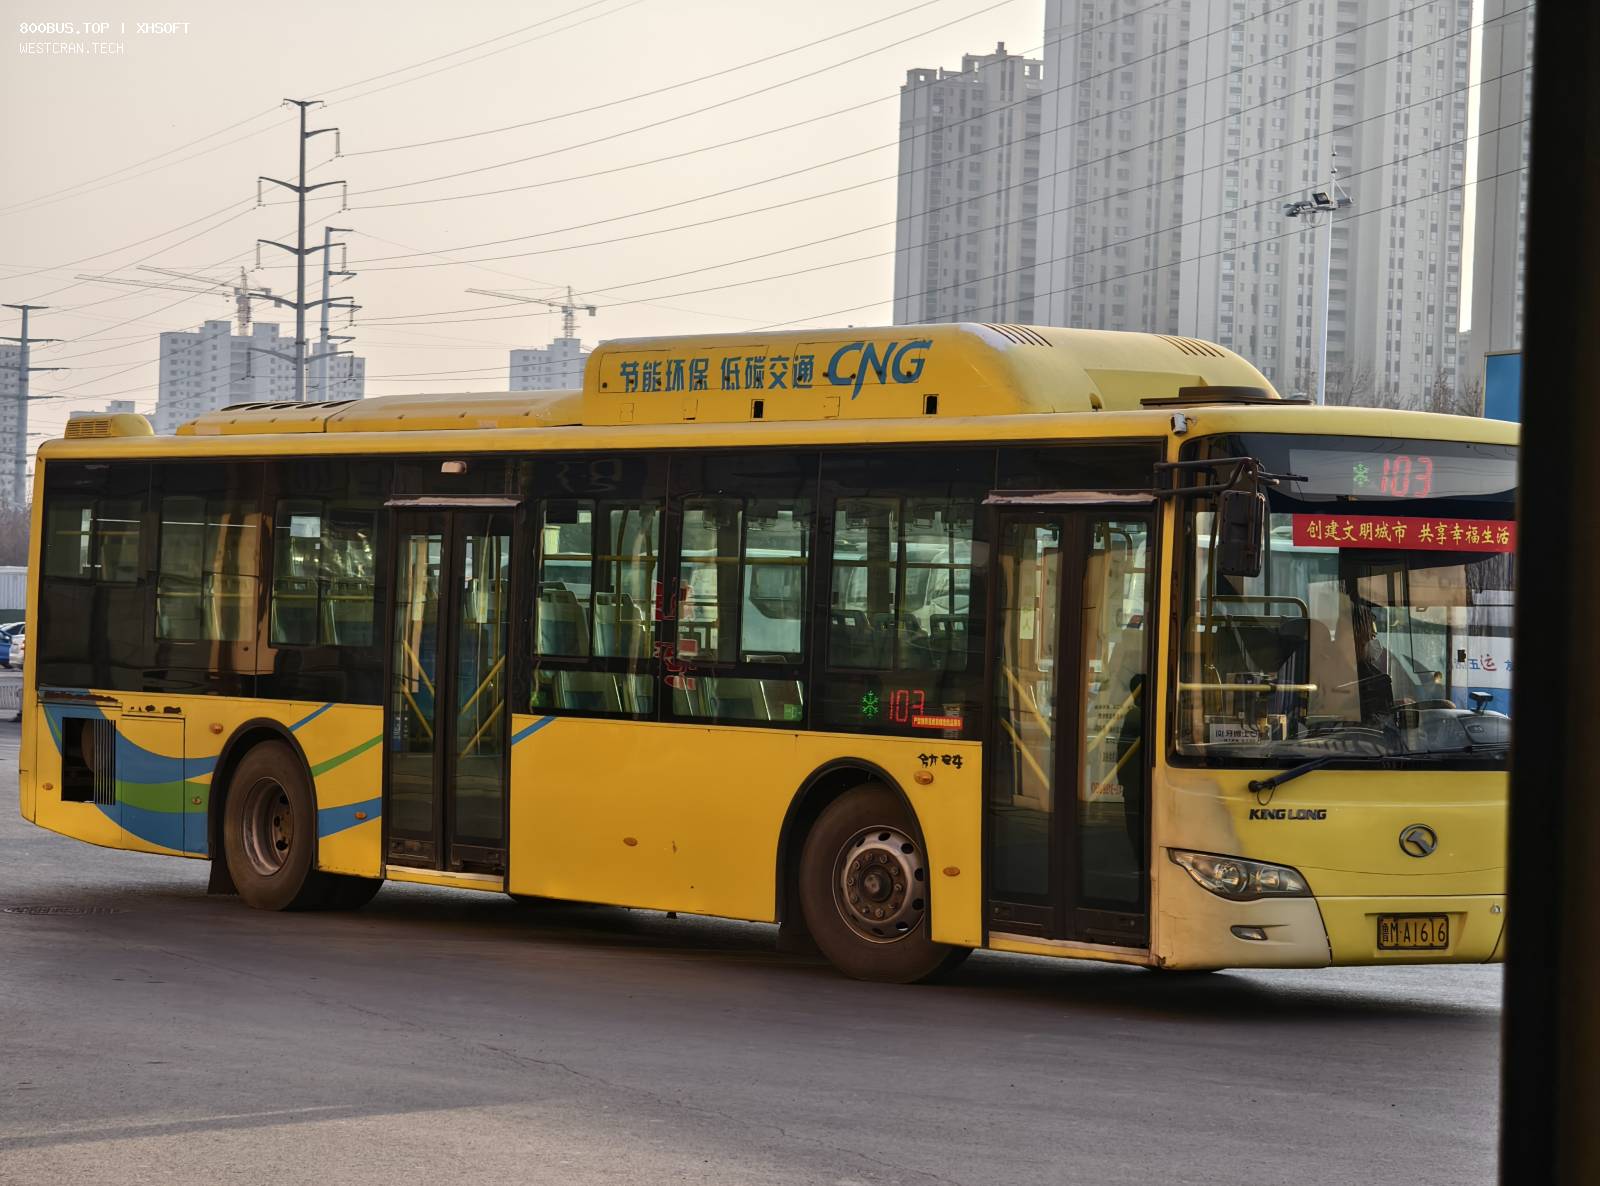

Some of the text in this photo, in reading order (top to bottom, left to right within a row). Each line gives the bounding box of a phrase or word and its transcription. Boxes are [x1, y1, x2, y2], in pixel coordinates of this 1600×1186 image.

[619, 340, 934, 400] 节能环保 低碳交通 CNG
[1380, 455, 1433, 498] 103
[1306, 520, 1511, 546] 创建文明城市 共享幸福生活
[889, 688, 926, 723] 103
[1249, 808, 1327, 820] KING LONG
